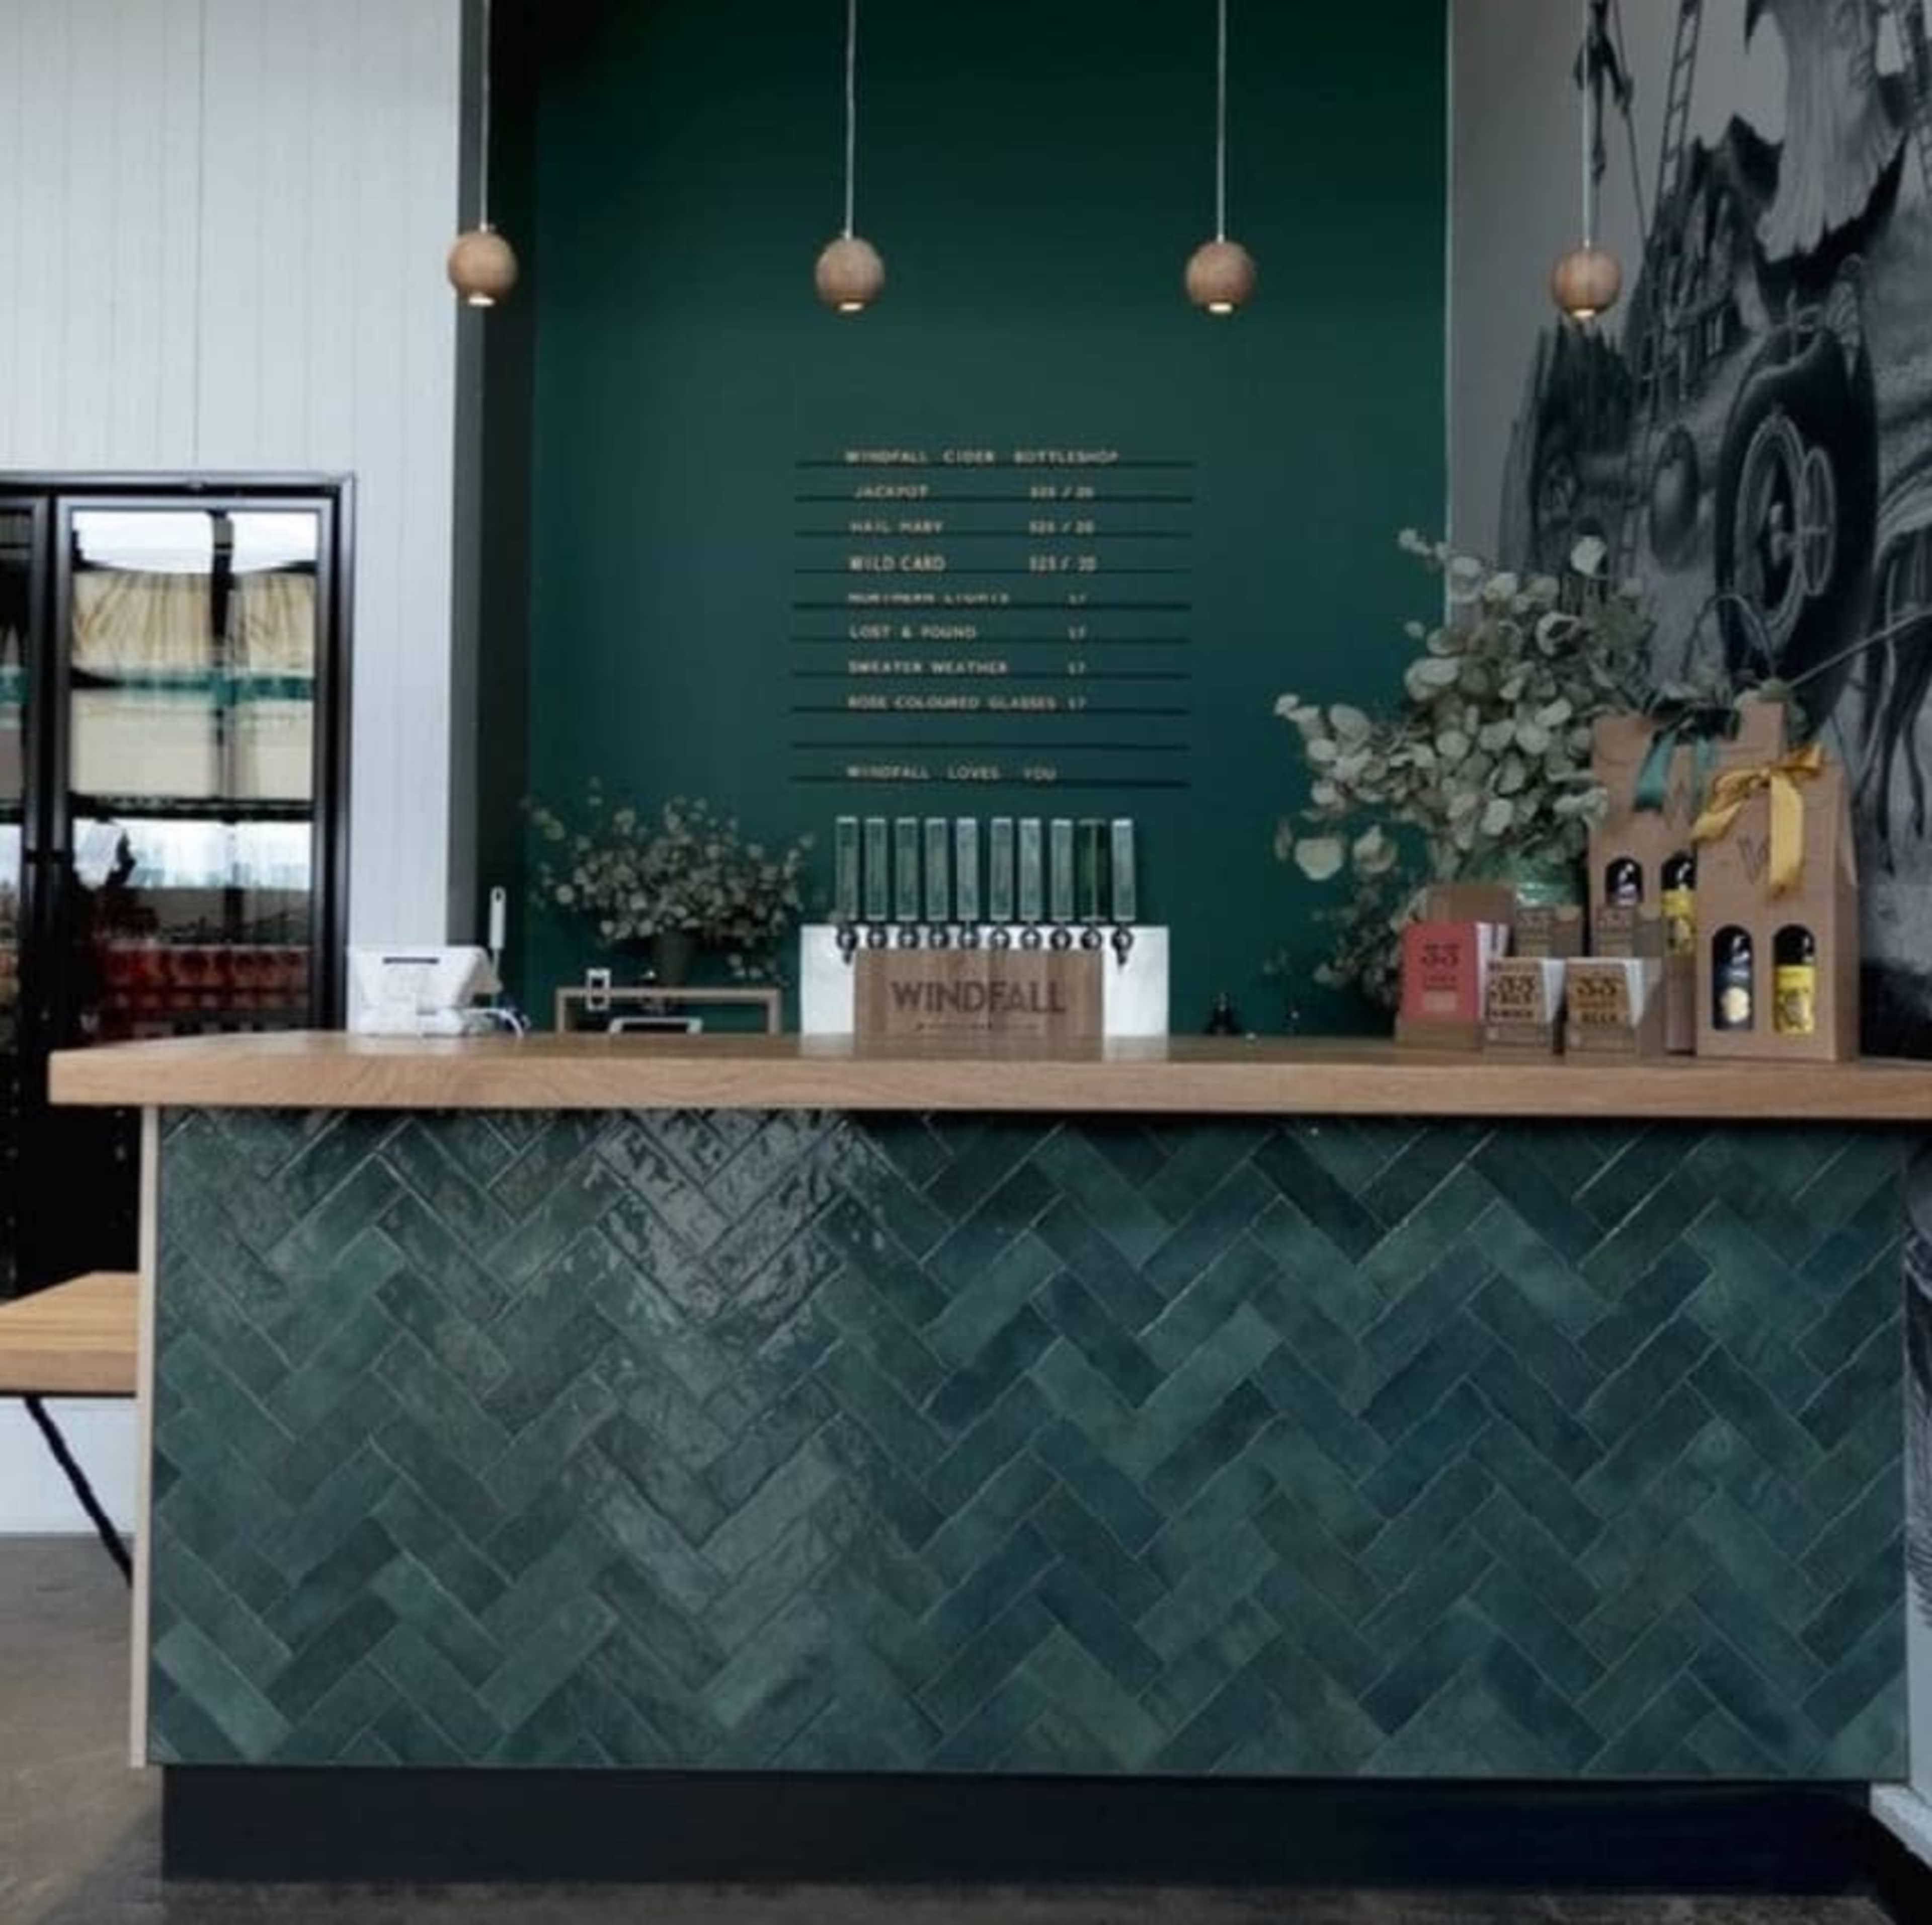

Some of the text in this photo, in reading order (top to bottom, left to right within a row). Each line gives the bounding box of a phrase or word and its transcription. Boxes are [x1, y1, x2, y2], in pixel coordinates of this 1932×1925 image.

[845, 449, 1118, 463] WINDFALL CIDER BOTTLESHOP
[854, 484, 929, 497] JACKPOT
[849, 520, 892, 533] HAIL
[899, 520, 944, 533] MARY
[849, 555, 896, 571] WILD
[900, 555, 947, 571] CARD
[849, 626, 891, 639] LOST
[920, 626, 977, 639] FOUND
[848, 660, 923, 674] SWEATER
[931, 660, 1008, 674] WEATHER
[848, 695, 887, 710] ROSE
[894, 695, 981, 710] COLOURED
[987, 695, 1057, 710] GLASSES
[847, 766, 1058, 781] WINDFALL LOVES YOU
[892, 980, 1066, 1014] WINDFALL
